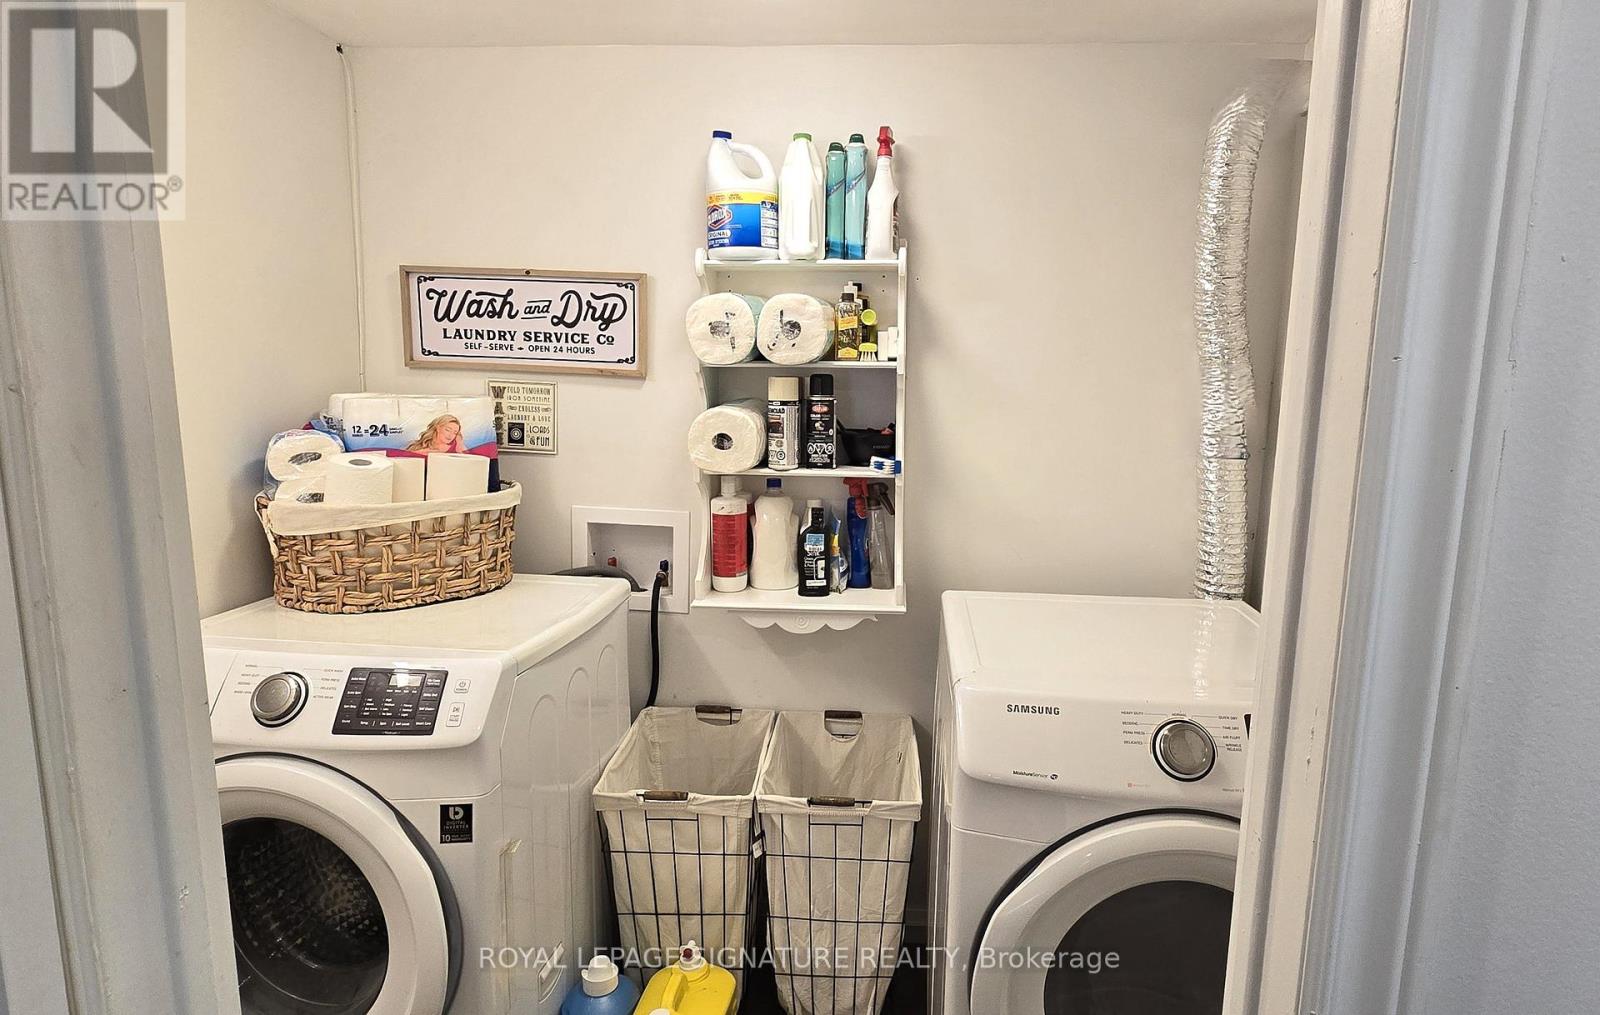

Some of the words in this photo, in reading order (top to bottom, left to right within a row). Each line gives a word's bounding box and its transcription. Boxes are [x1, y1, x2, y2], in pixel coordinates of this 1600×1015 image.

[426, 288, 519, 323] Wash
[522, 300, 552, 319] and
[551, 290, 627, 331] Dry
[443, 328, 517, 342] LAUNDRY
[523, 331, 590, 344] SERVICE
[464, 343, 514, 351] SELF-SERVE
[528, 345, 550, 353] OPEN
[554, 345, 563, 353] 24
[566, 346, 595, 354] HOURS
[352, 425, 361, 434] 12
[369, 424, 389, 437] 24
[529, 425, 550, 434] LOADS
[536, 436, 549, 446] FUN
[1007, 704, 1060, 715] SAMSUNG
[441, 834, 451, 842] 10
